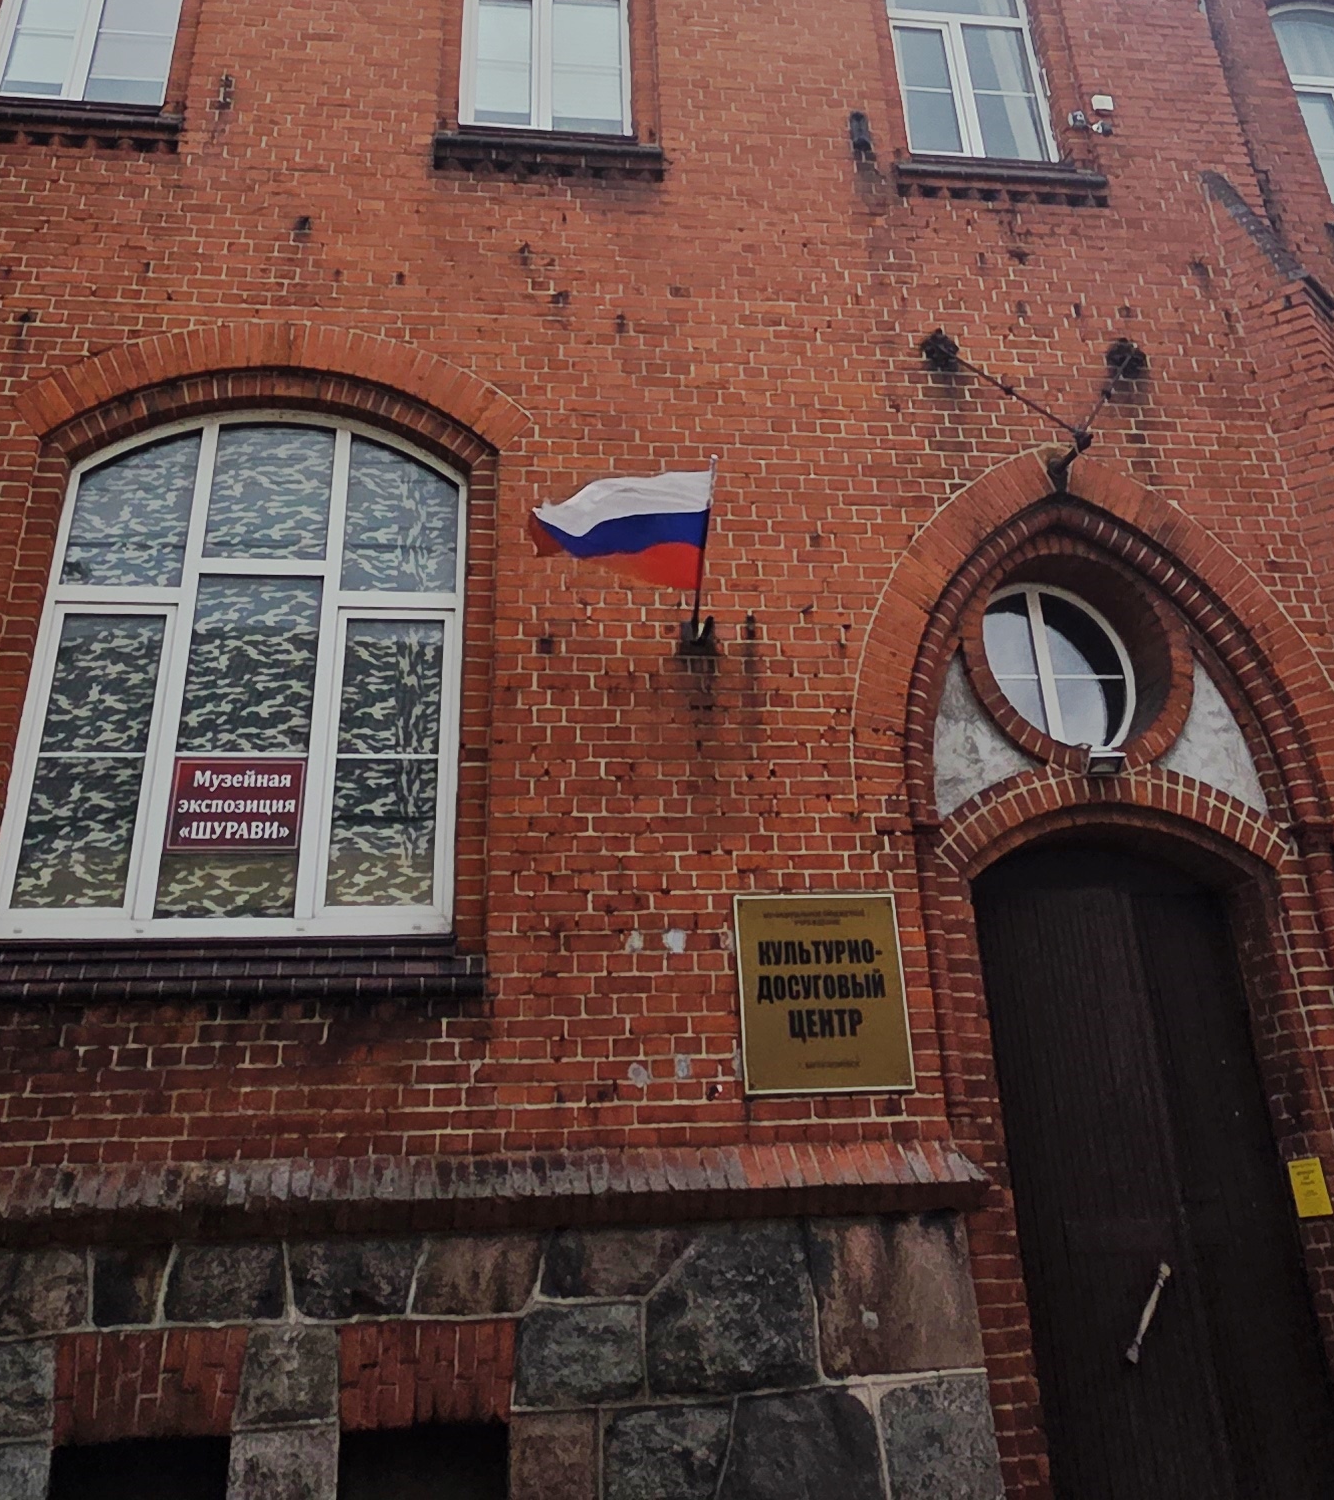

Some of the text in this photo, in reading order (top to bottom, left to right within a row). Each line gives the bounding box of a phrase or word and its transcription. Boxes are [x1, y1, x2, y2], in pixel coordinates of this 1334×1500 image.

[193, 770, 292, 792] Музейная
[177, 799, 296, 815] экспозиция
[179, 821, 290, 839] «ШУРАВИ»
[758, 939, 883, 966] КУЛЬТУРНО-
[757, 968, 886, 1004] ДОСУГОВЫЙ
[788, 1008, 863, 1043] ЦЕНТР
